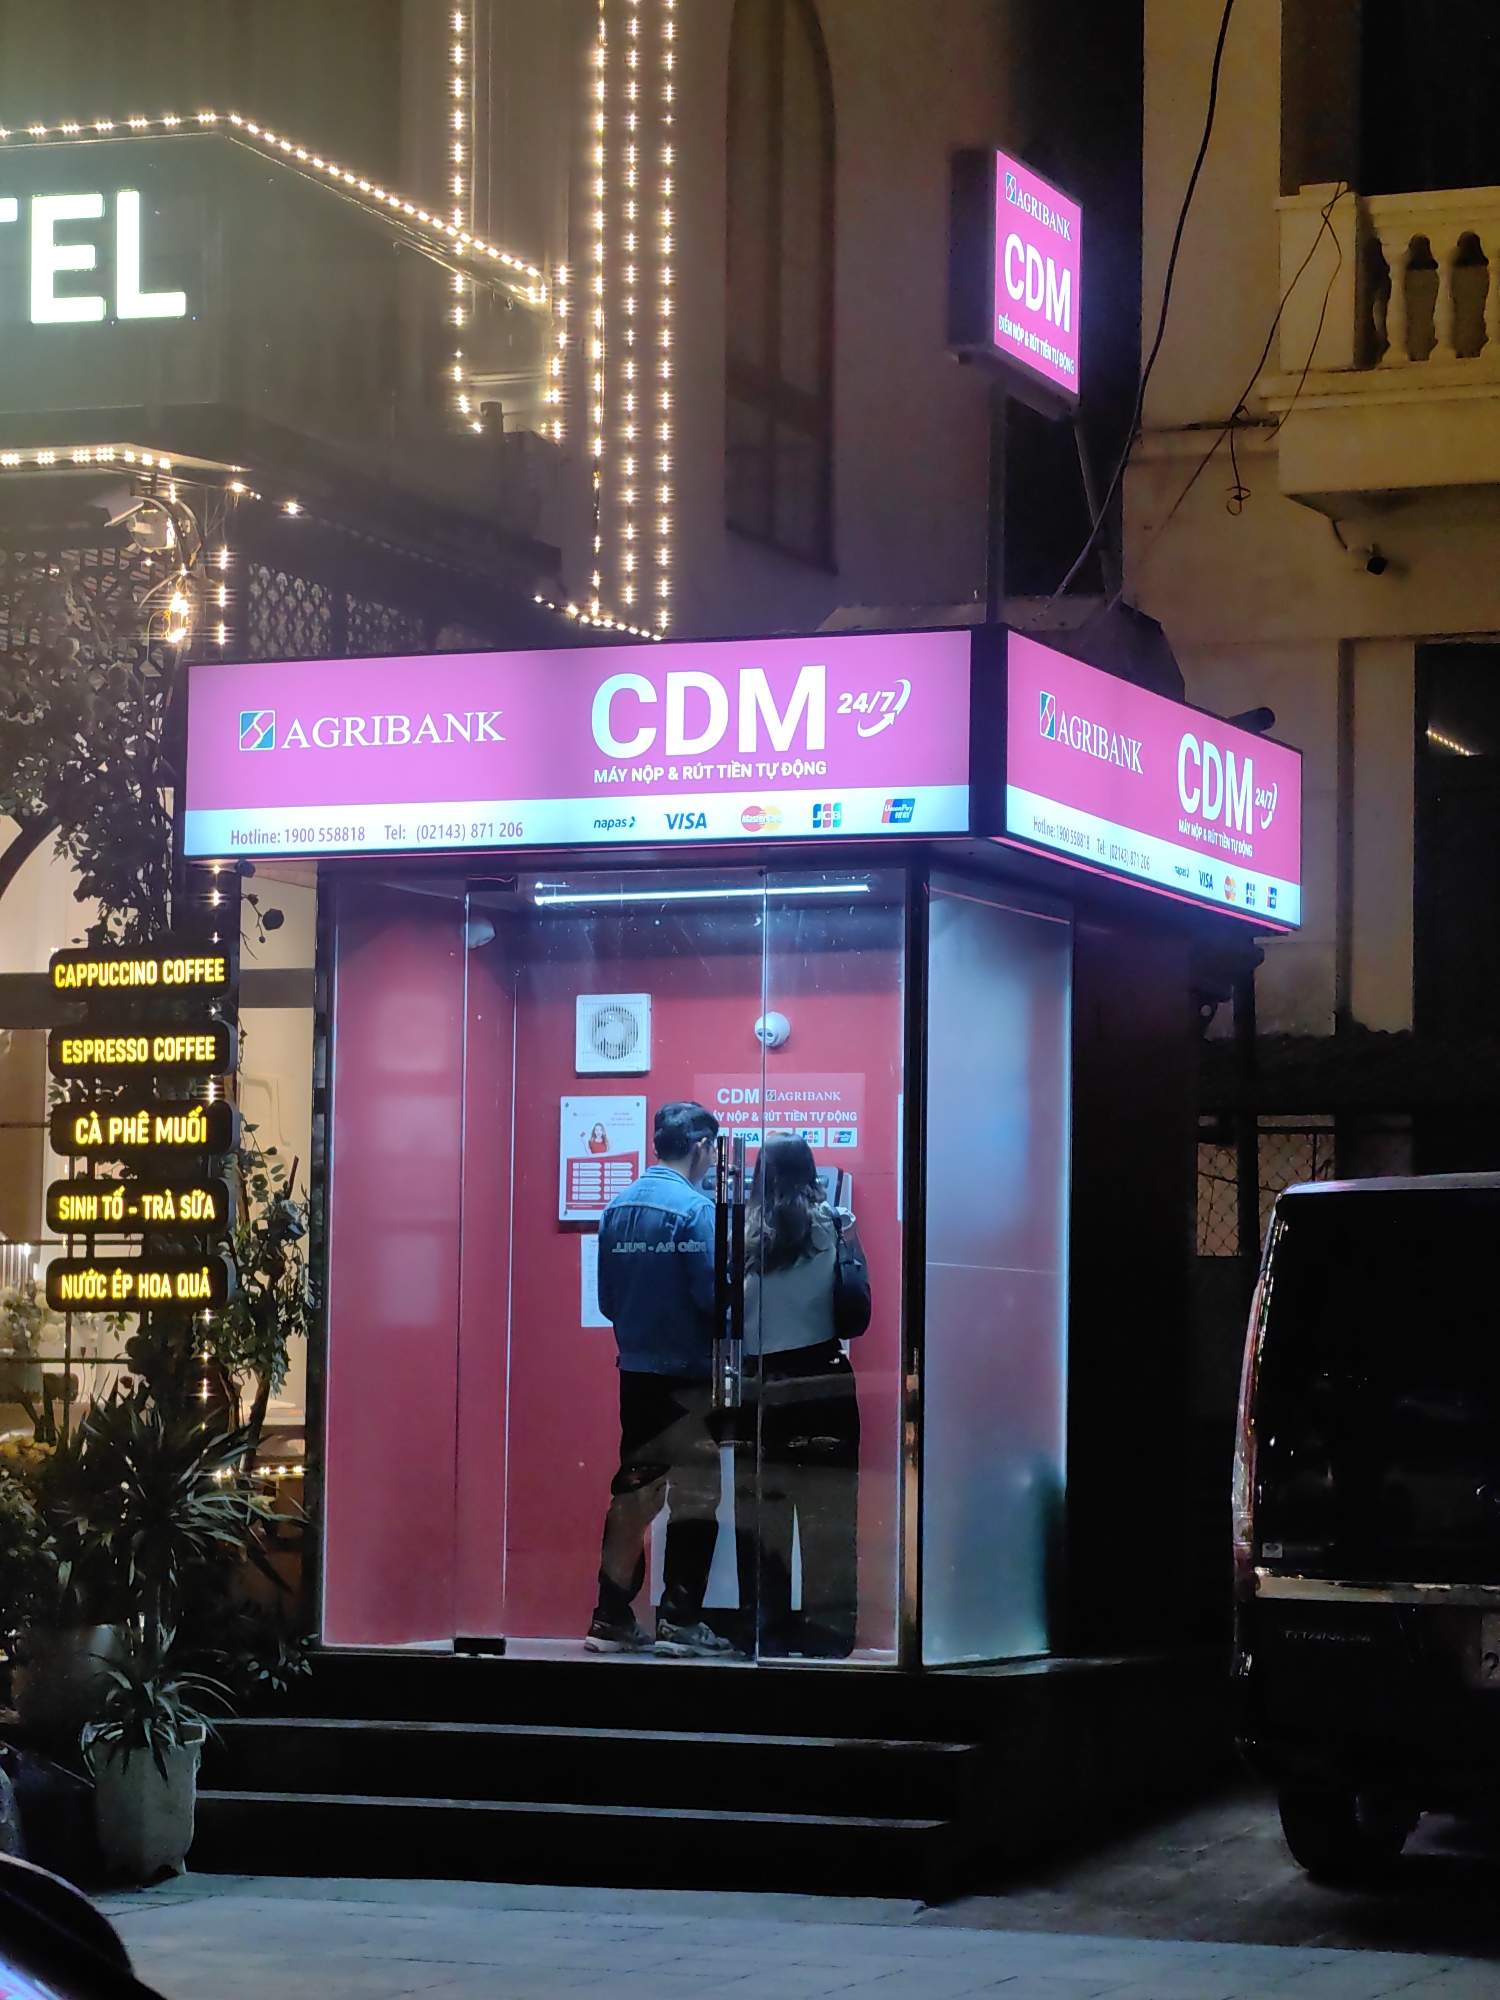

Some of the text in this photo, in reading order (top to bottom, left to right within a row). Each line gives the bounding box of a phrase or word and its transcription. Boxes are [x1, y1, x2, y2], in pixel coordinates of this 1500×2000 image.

[1018, 188, 1071, 242] AGRIBANK
[0, 188, 187, 324] EL
[1004, 233, 1071, 333] CDM
[591, 665, 827, 759] CDM
[837, 688, 895, 715] 24/7
[281, 710, 506, 749] AGRIBANK
[1056, 713, 1144, 774] AGRIBANK
[594, 758, 827, 785] MÁY NỘP & RÚT TIỀN TỰ ĐỘNG
[1178, 732, 1253, 835] CDM
[230, 826, 365, 845] Hotline: 1900 558818
[384, 821, 523, 842] Tel: (02143) 871 206
[593, 817, 627, 831] napas
[663, 812, 707, 830] VISA
[1198, 870, 1213, 890] VISA
[54, 957, 225, 988] CAPPUCCINO COFFEE
[62, 1035, 216, 1064] ESPRESSO COFFEE
[717, 1088, 760, 1104] CDM
[777, 1091, 841, 1101] AGRIBANK
[75, 1104, 207, 1145] CÀ PHÊ MUỐI
[713, 1109, 857, 1123] ÁY NỘP & RÚT TIỀN TỰ ĐỘNG
[58, 1195, 97, 1220] SINH
[101, 1185, 125, 1220] TỐ
[142, 1188, 176, 1220] TRÀ
[180, 1189, 216, 1220] SỮA
[61, 1266, 212, 1300] NƯỚC ÉP HOA QUẢ
